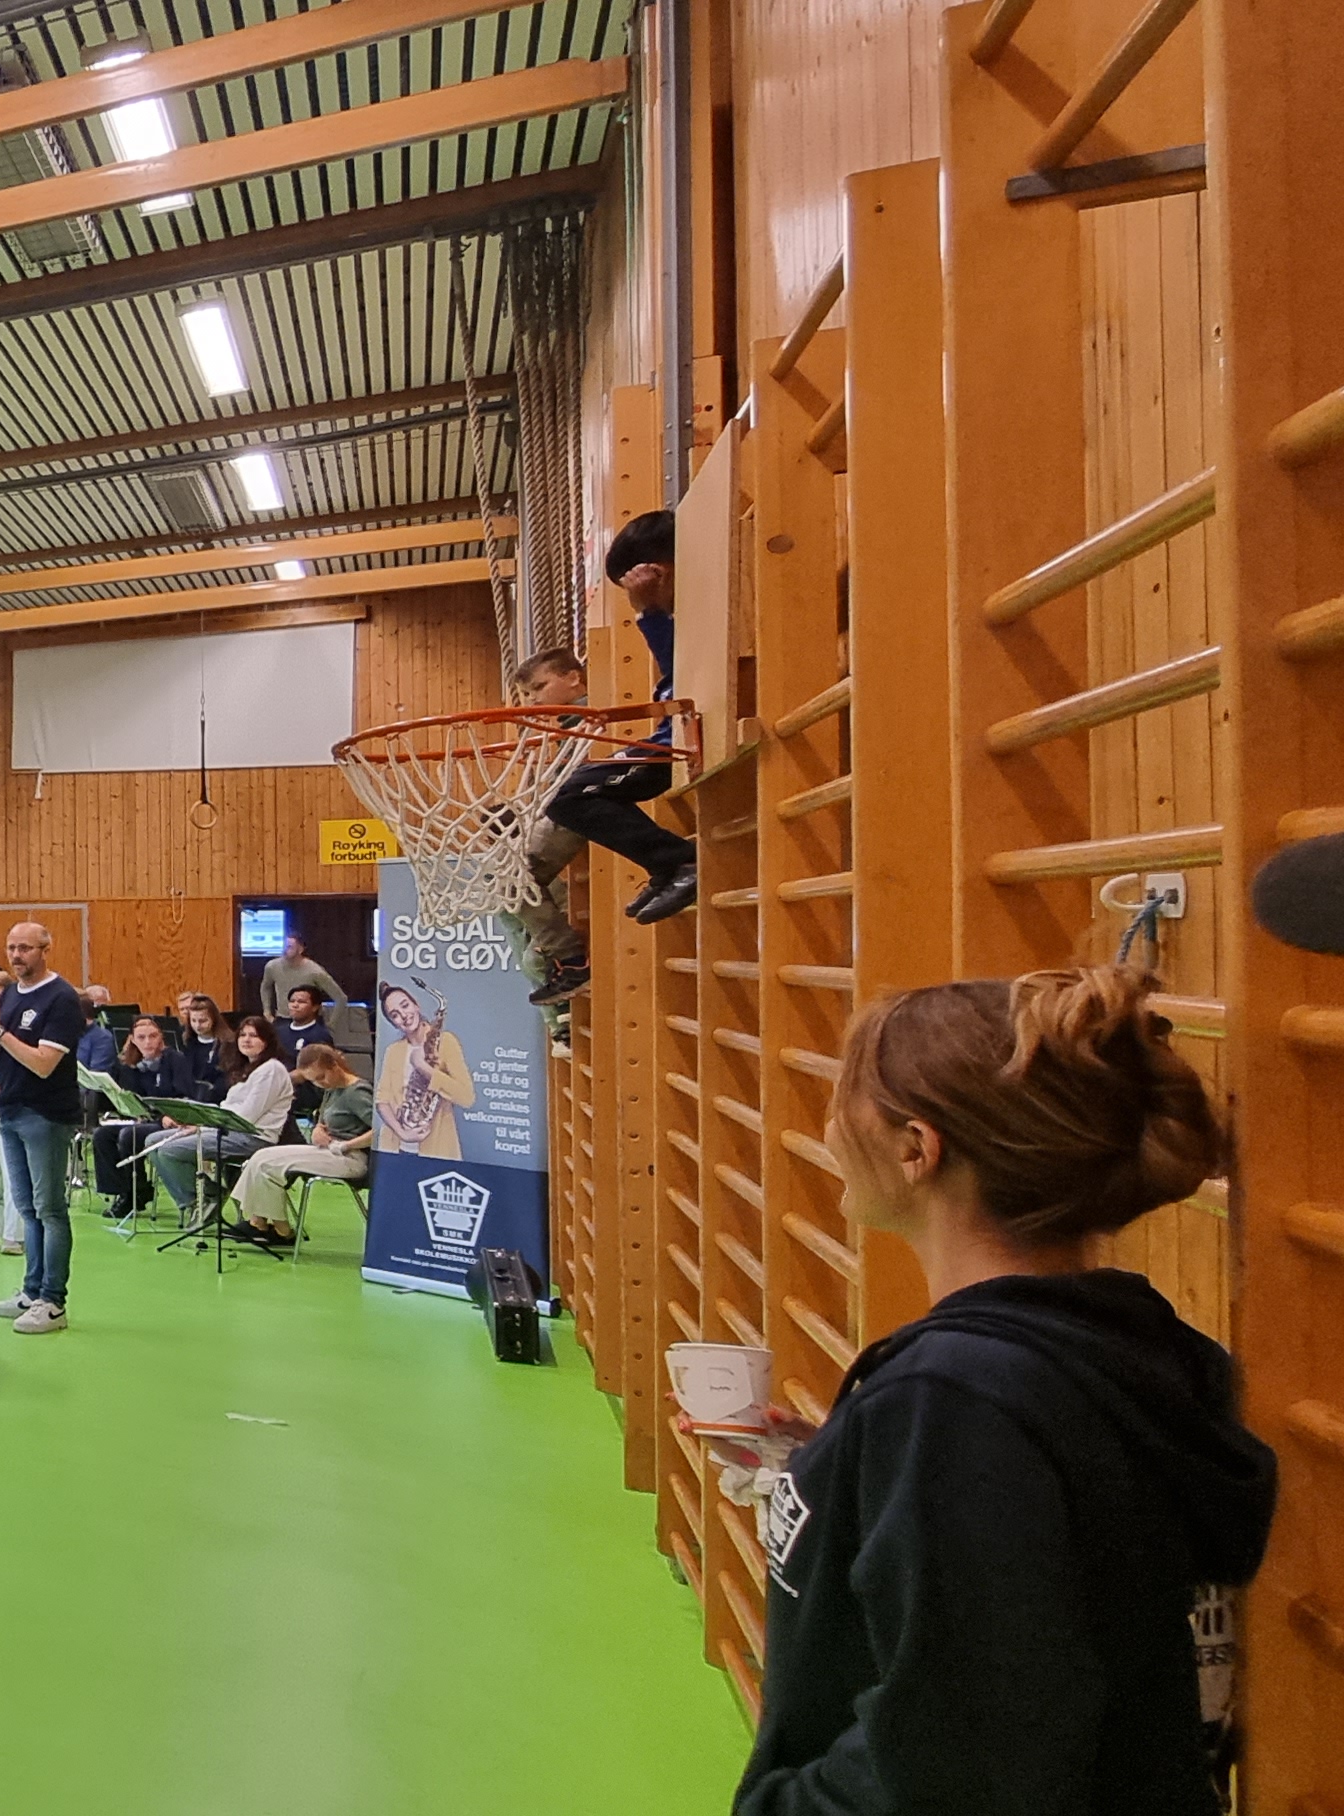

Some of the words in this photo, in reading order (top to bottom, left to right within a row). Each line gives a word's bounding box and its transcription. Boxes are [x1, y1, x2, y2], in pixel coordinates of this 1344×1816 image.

[330, 851, 377, 861] forbudt
[392, 914, 506, 942] SOSIAL
[390, 942, 437, 970] OG
[494, 1046, 529, 1059] Gutter
[479, 1060, 495, 1071] og
[498, 1060, 529, 1073] jenter
[472, 1071, 490, 1082] fra
[491, 1072, 499, 1083] 8
[514, 1077, 529, 1088] og
[482, 1087, 530, 1099] oppover
[463, 1111, 531, 1127] velkommen
[496, 1127, 507, 1137] til
[494, 1140, 531, 1155] korps!
[442, 1229, 464, 1239] SMK
[432, 1243, 475, 1256] VENNESLA
